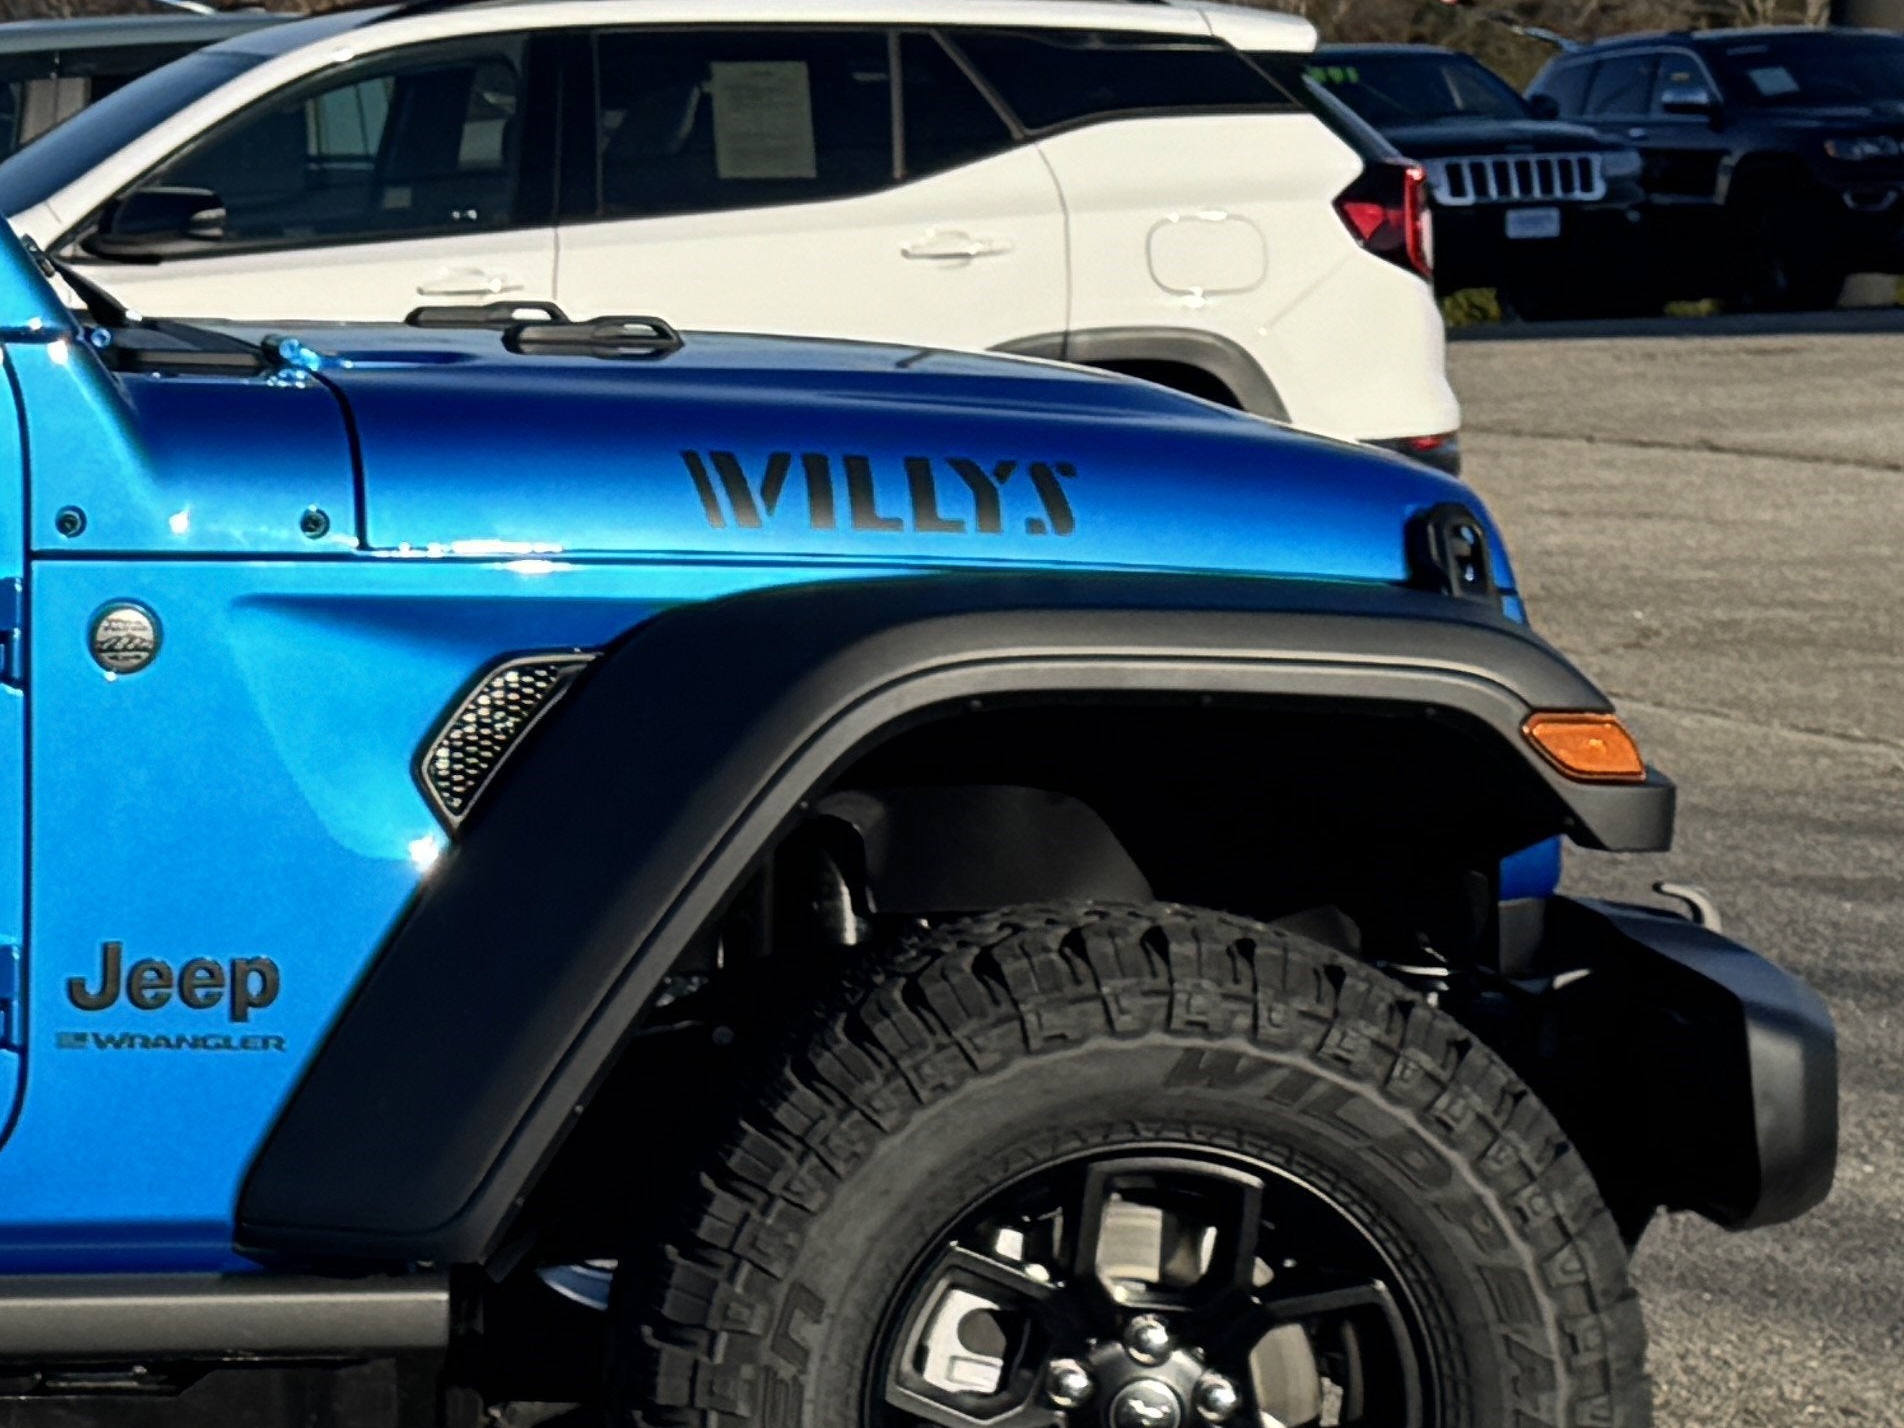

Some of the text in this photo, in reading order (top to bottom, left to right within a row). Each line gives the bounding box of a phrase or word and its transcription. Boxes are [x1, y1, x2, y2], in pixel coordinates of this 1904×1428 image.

[680, 448, 1078, 537] WILLYS
[66, 940, 280, 1023] Jeep
[93, 1032, 288, 1052] WRANGLER
